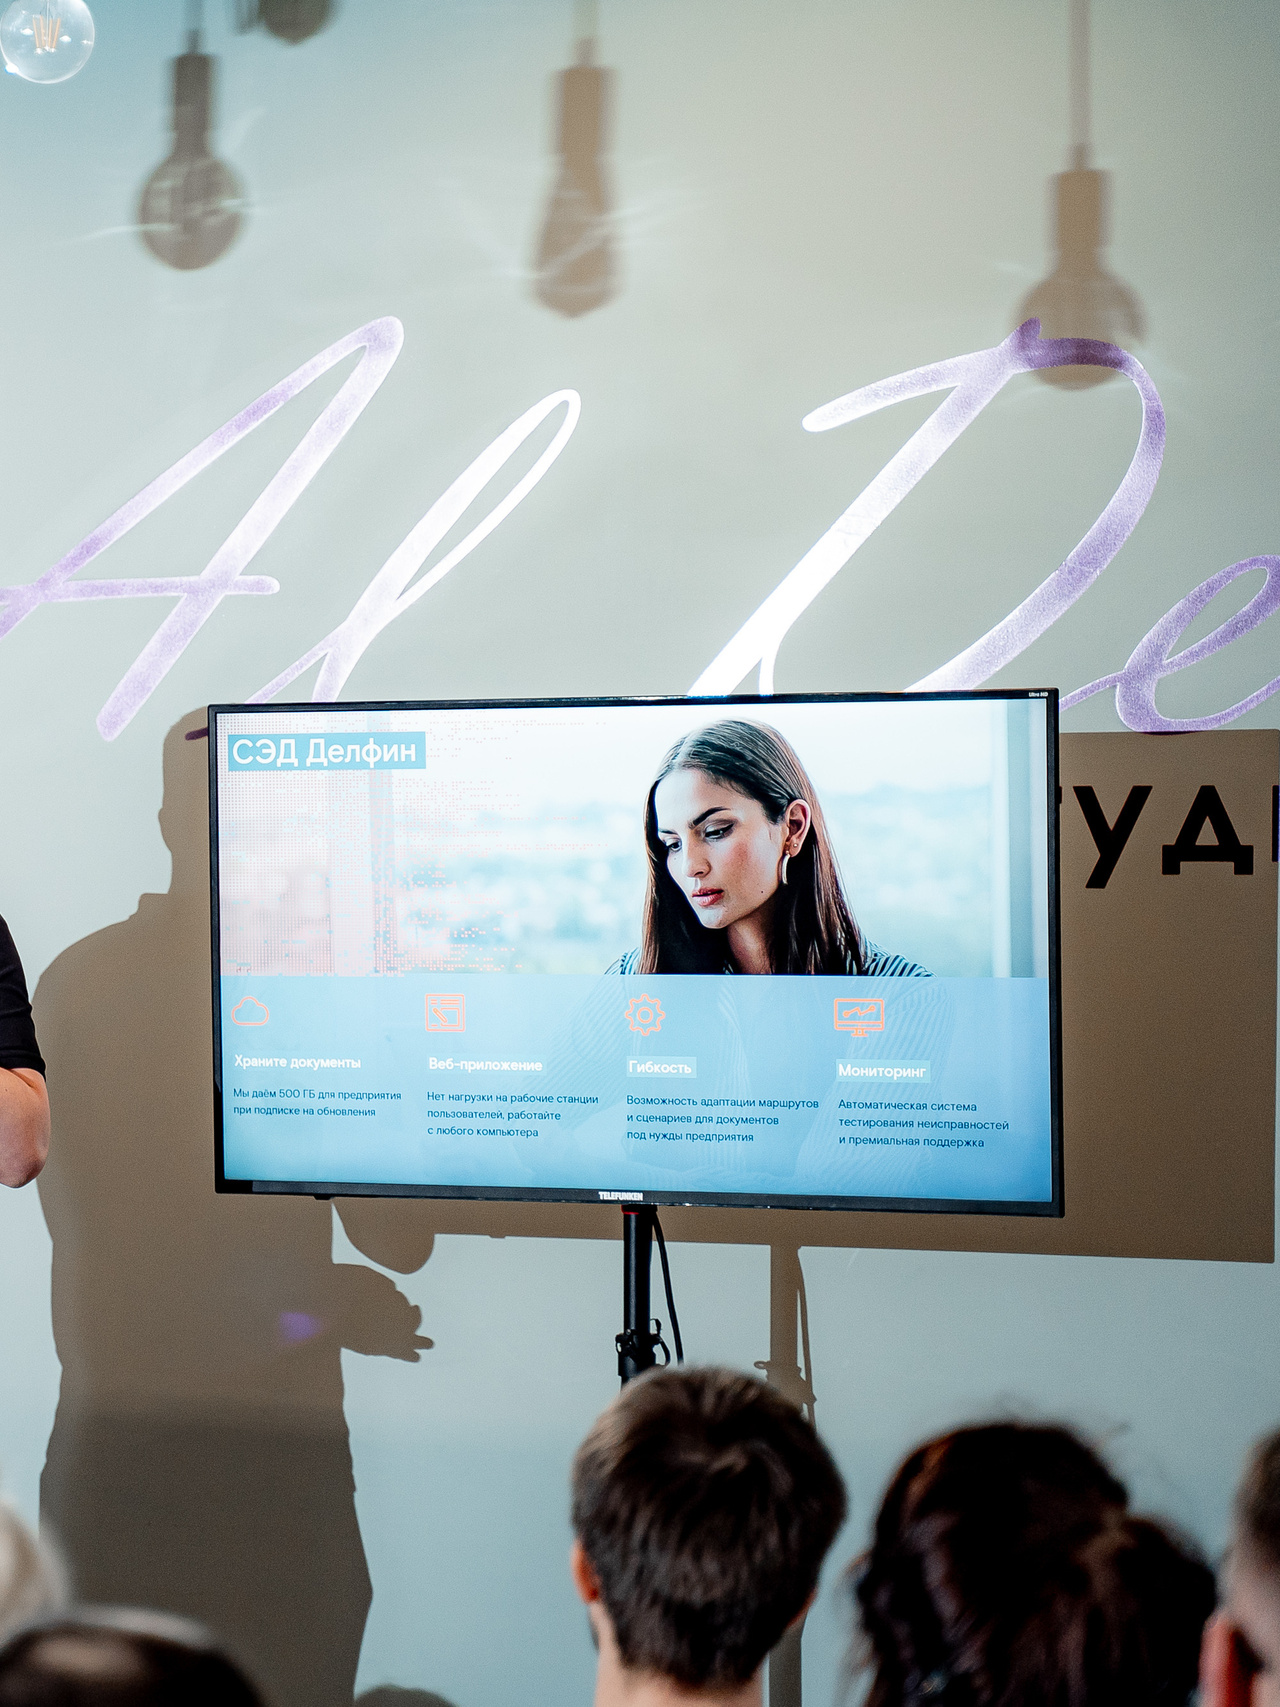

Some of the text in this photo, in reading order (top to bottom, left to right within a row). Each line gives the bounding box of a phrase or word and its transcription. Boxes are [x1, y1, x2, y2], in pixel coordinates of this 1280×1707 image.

[233, 738, 415, 768] СЭД Делфин
[234, 1053, 362, 1071] Храните документы
[428, 1056, 544, 1074] Веб-приложение
[628, 1059, 692, 1074] Гибкость
[838, 1063, 927, 1081] Мониторинг
[233, 1087, 250, 1098] Мы
[278, 1088, 301, 1099] 500
[302, 1088, 316, 1099] ГБ
[317, 1091, 336, 1100] для
[337, 1091, 402, 1102] предприятия
[426, 1091, 599, 1105] Нет нагрузки на рабочие станции
[626, 1094, 820, 1111] Возможность адаптации маршрутов
[837, 1098, 978, 1112] Автоматическая система
[233, 1106, 376, 1117] при подписке на обновления
[427, 1109, 562, 1122] пользователей, работайте
[627, 1114, 779, 1127] и сценариев для документов
[838, 1118, 1010, 1132] тестирования неисправностей
[428, 1125, 539, 1139] с любого компьютера
[626, 1131, 754, 1144] под нужды предприятия
[839, 1136, 985, 1149] и премиальная поддержка
[598, 1191, 644, 1201] TELEFUNKEN
